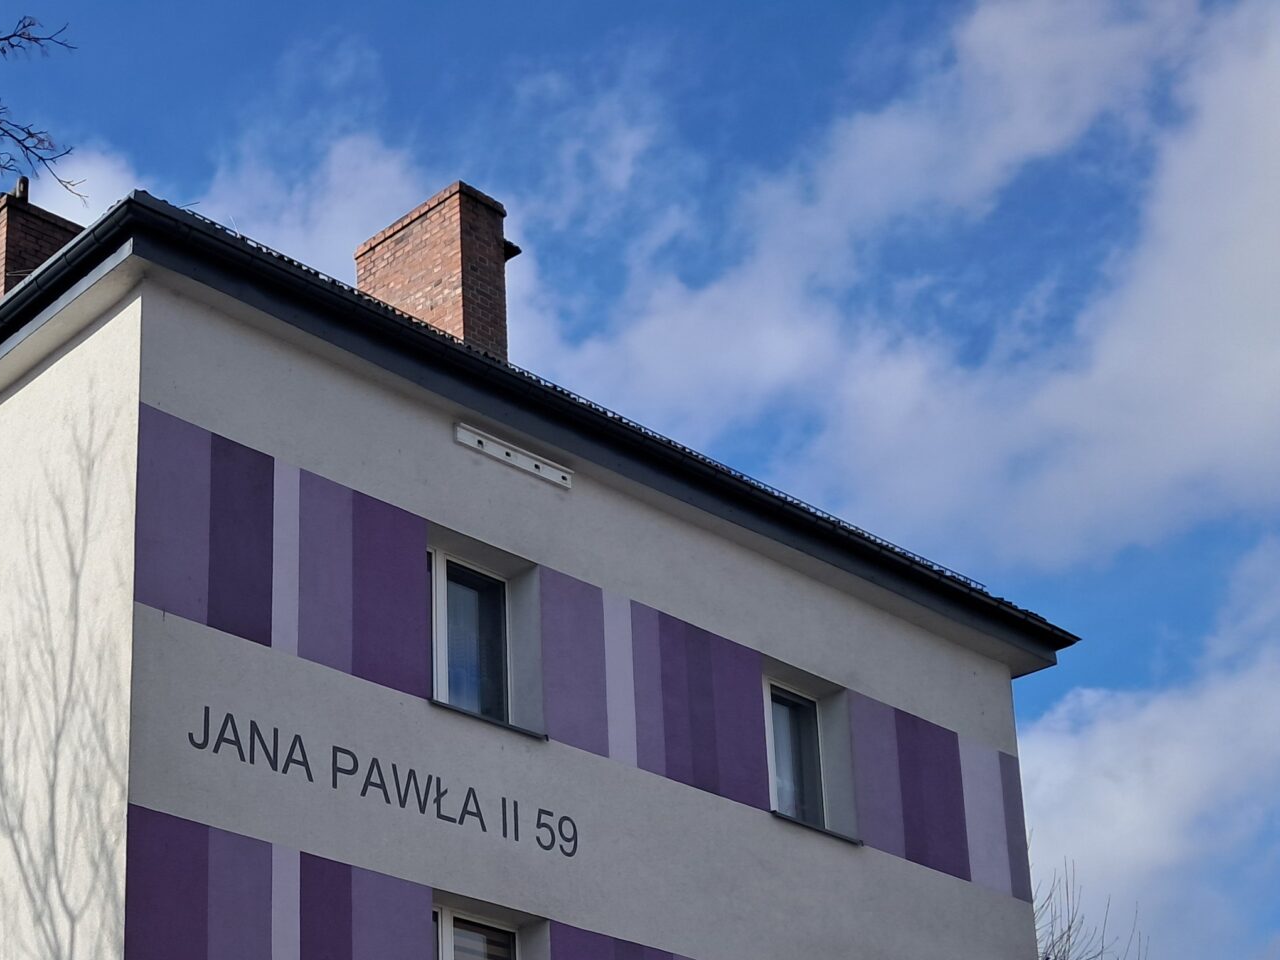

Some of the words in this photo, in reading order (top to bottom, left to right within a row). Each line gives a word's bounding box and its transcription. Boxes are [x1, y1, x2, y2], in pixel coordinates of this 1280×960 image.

[188, 705, 314, 783] JANA
[331, 745, 488, 833] PAWŁA
[501, 796, 520, 842] II
[535, 808, 579, 858] 59
